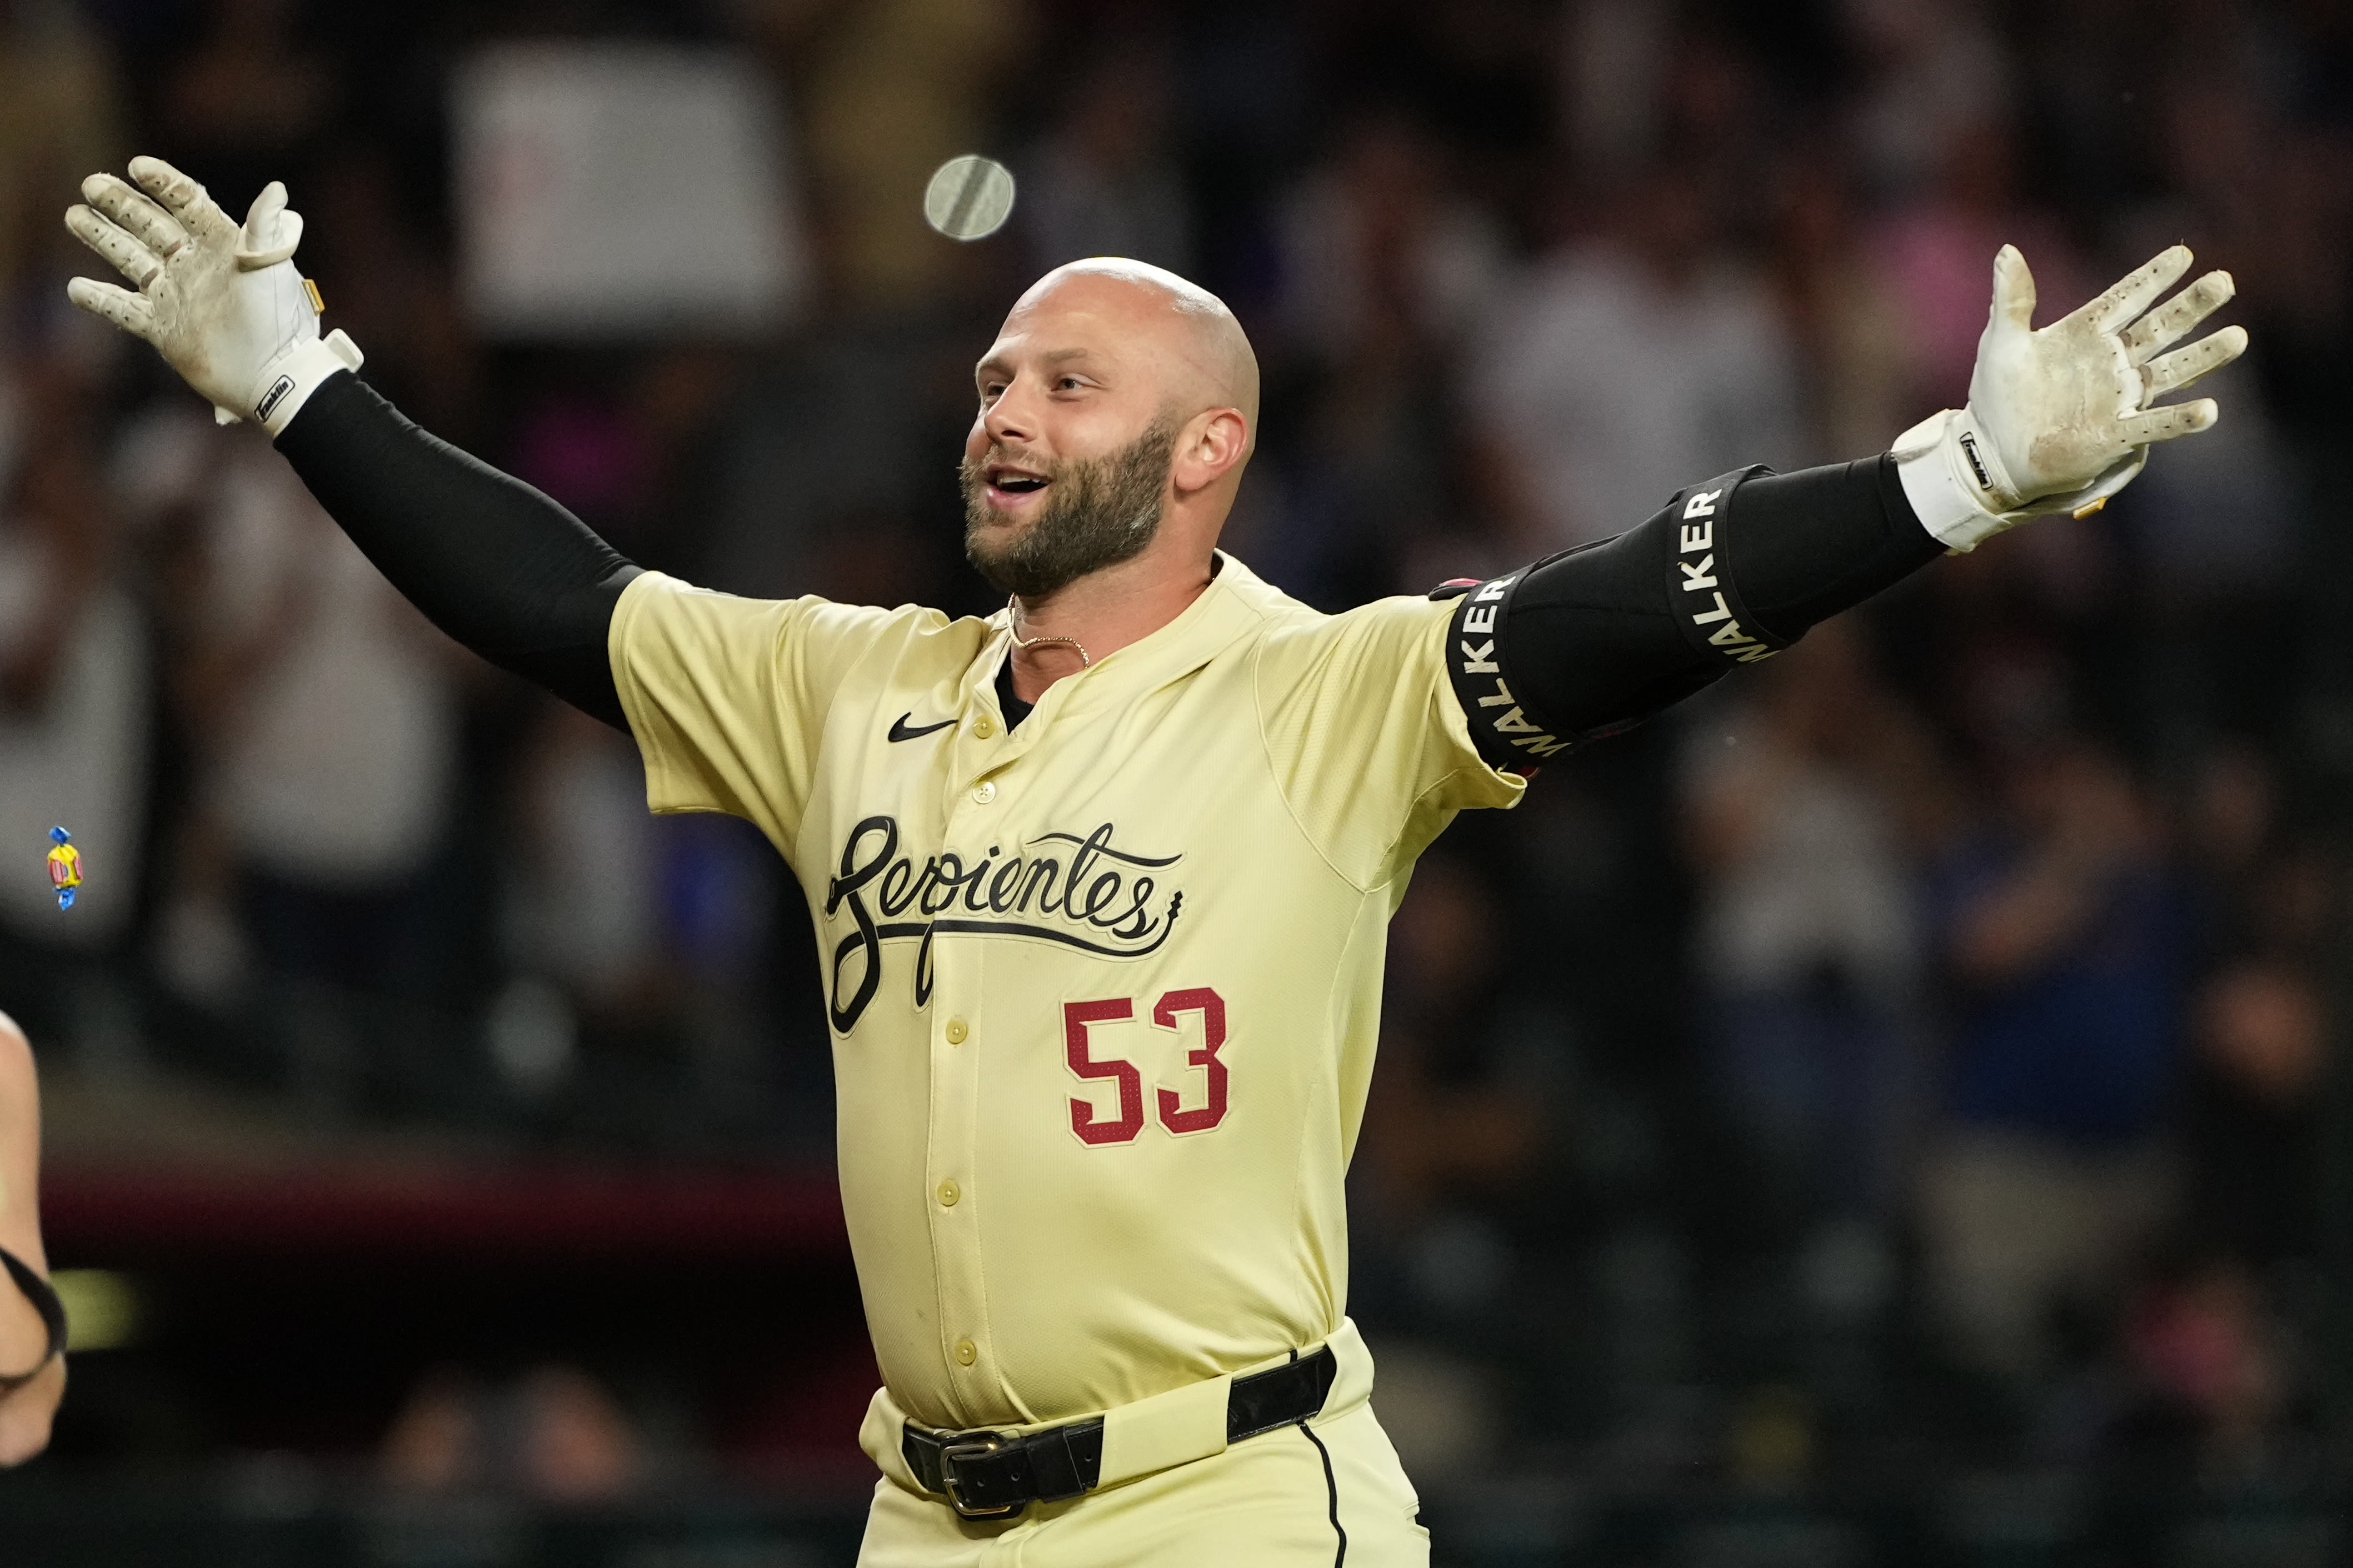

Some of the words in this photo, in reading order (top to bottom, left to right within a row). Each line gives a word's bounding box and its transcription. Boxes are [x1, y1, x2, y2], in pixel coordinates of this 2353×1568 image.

[258, 381, 289, 420] Franklin
[1678, 489, 1781, 663] WALKER
[1461, 575, 1572, 758] WALKER
[1063, 987, 1229, 1145] 53
